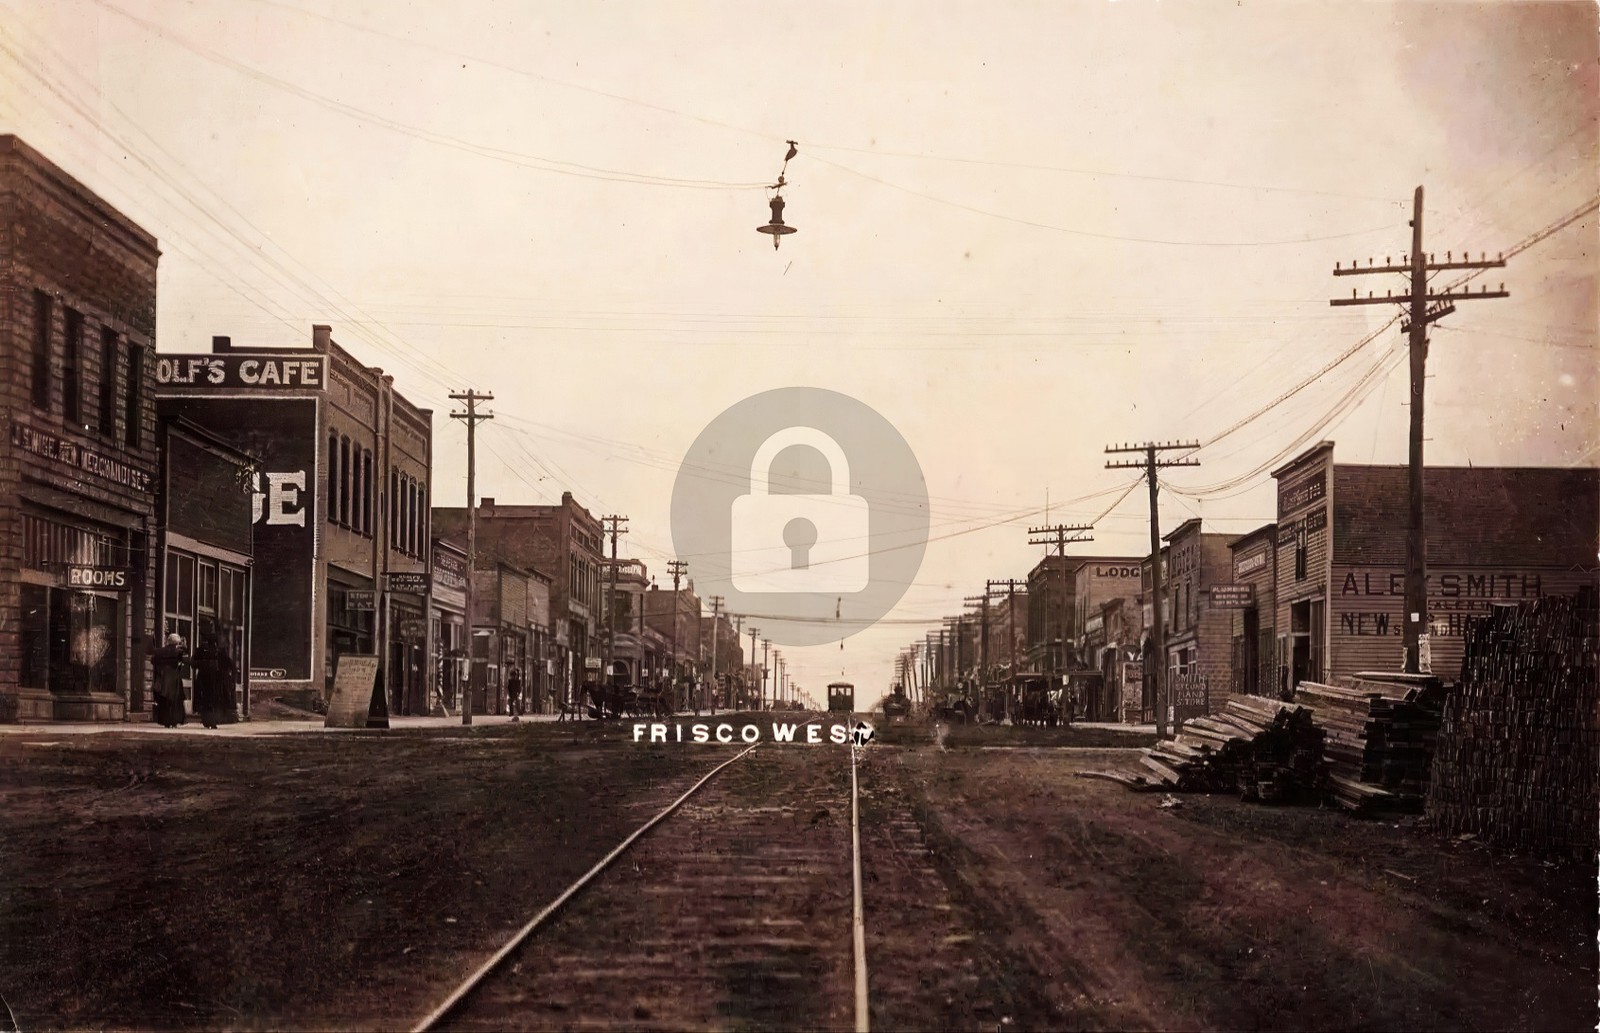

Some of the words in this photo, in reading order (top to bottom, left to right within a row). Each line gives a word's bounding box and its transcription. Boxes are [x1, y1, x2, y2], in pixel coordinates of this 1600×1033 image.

[239, 360, 319, 385] CAFE
[70, 568, 125, 587] ROOMS
[1096, 566, 1140, 578] LODG
[1342, 572, 1431, 596] ALE
[1441, 574, 1541, 597] SMITH
[1341, 612, 1389, 636] NEW
